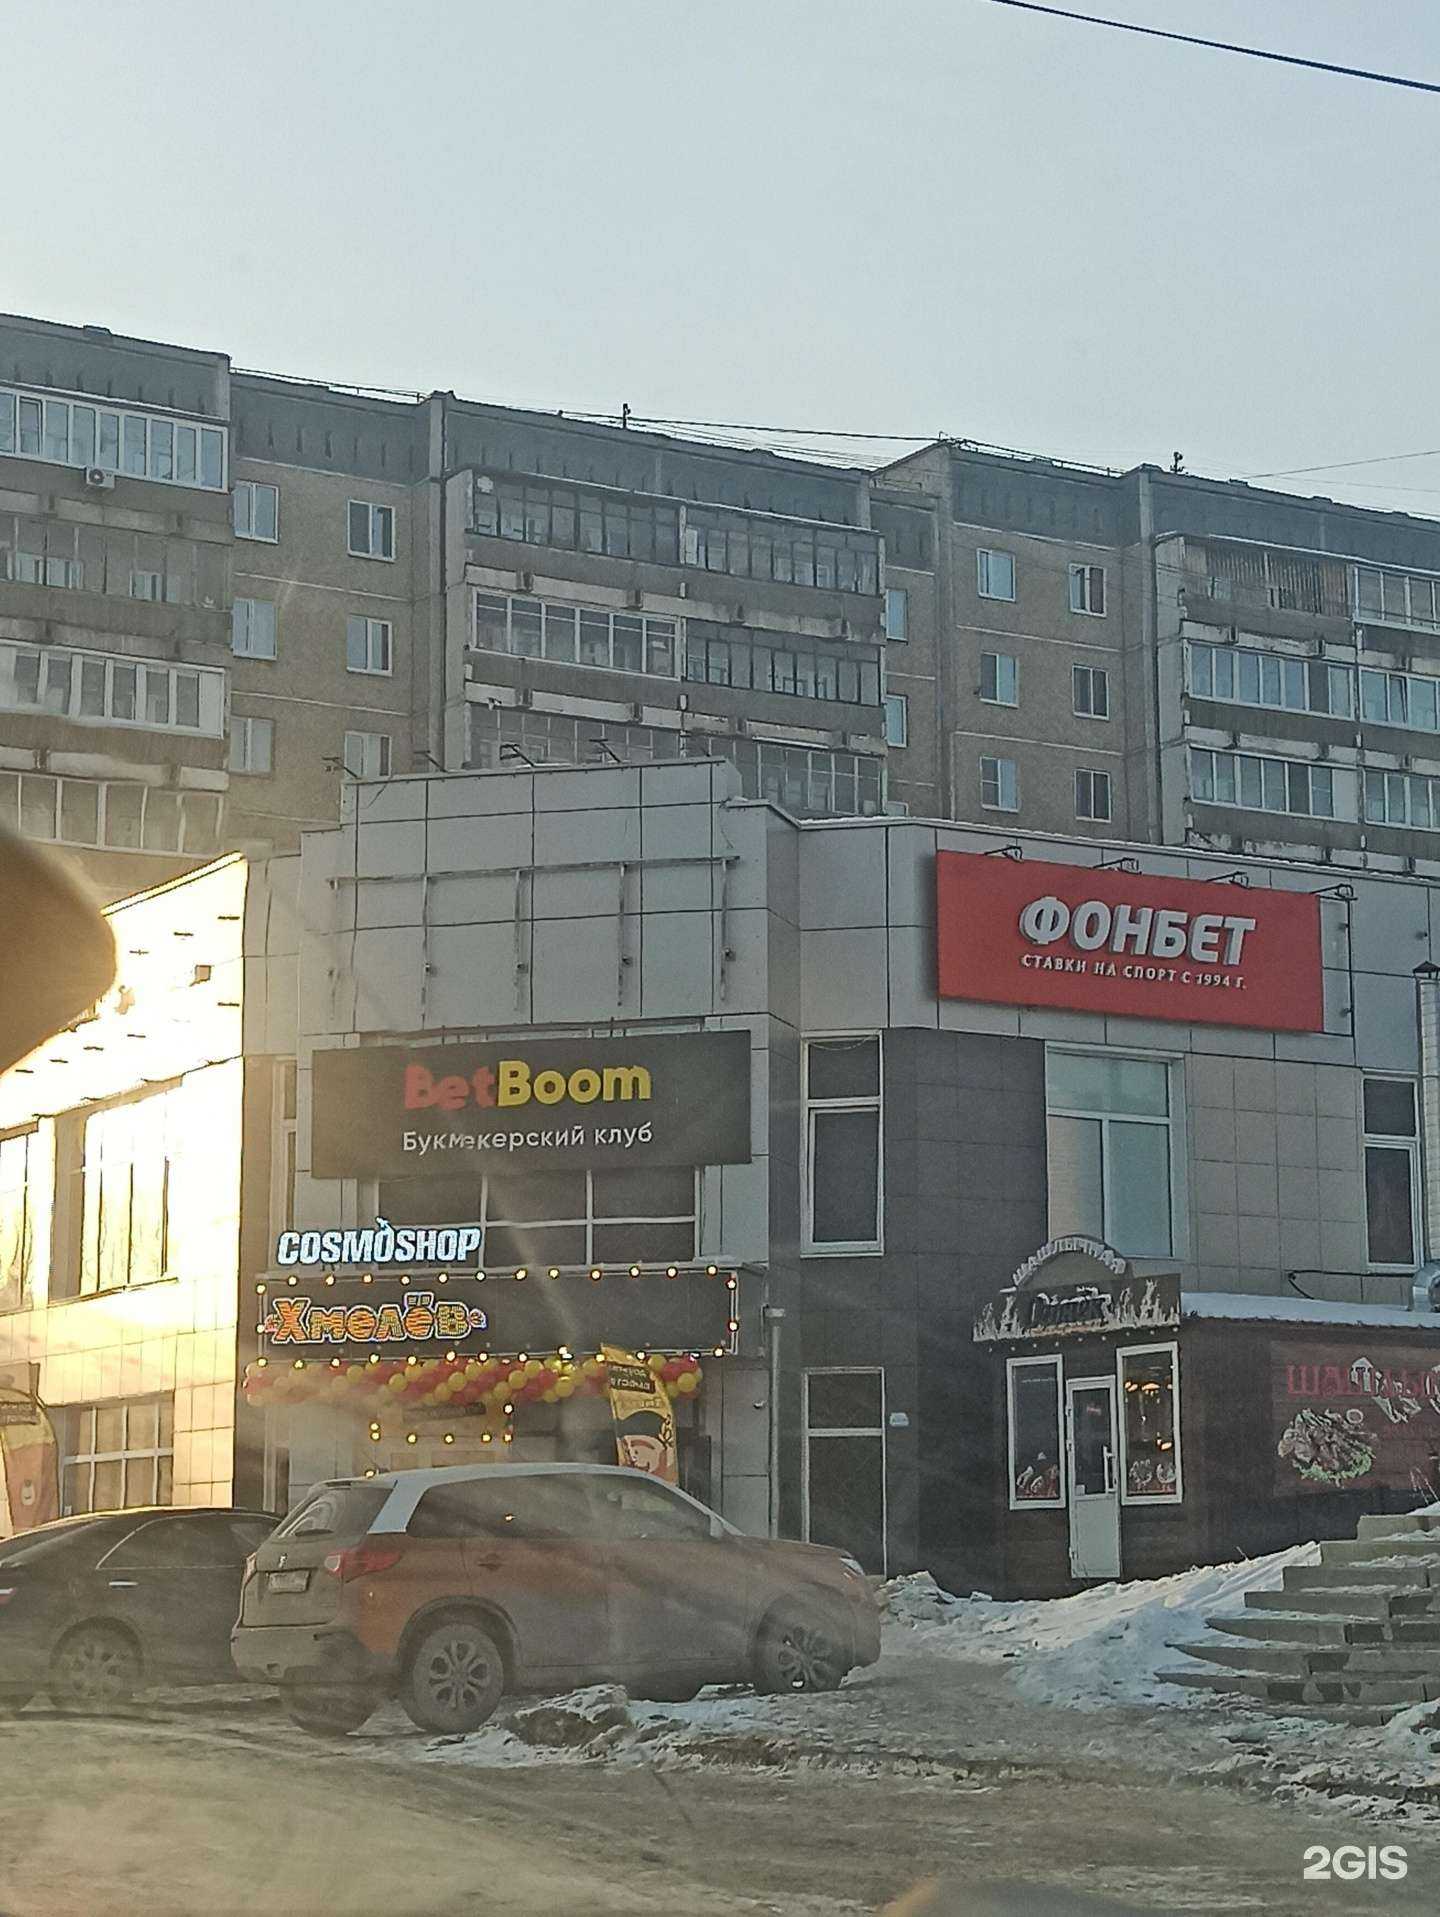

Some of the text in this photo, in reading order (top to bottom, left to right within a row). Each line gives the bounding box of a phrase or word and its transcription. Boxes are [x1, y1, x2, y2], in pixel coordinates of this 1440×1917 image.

[1019, 896, 1257, 966] ФОНБЕТ
[1021, 953, 1086, 974] СТАВКИ
[1093, 962, 1117, 978] НА
[1122, 964, 1177, 984] СПОРТ
[1182, 970, 1191, 984] С
[1195, 973, 1231, 989] 1994
[404, 1059, 652, 1111] BetBoom
[594, 1120, 653, 1150] клуб
[277, 1218, 482, 1266] COSMOSHOP
